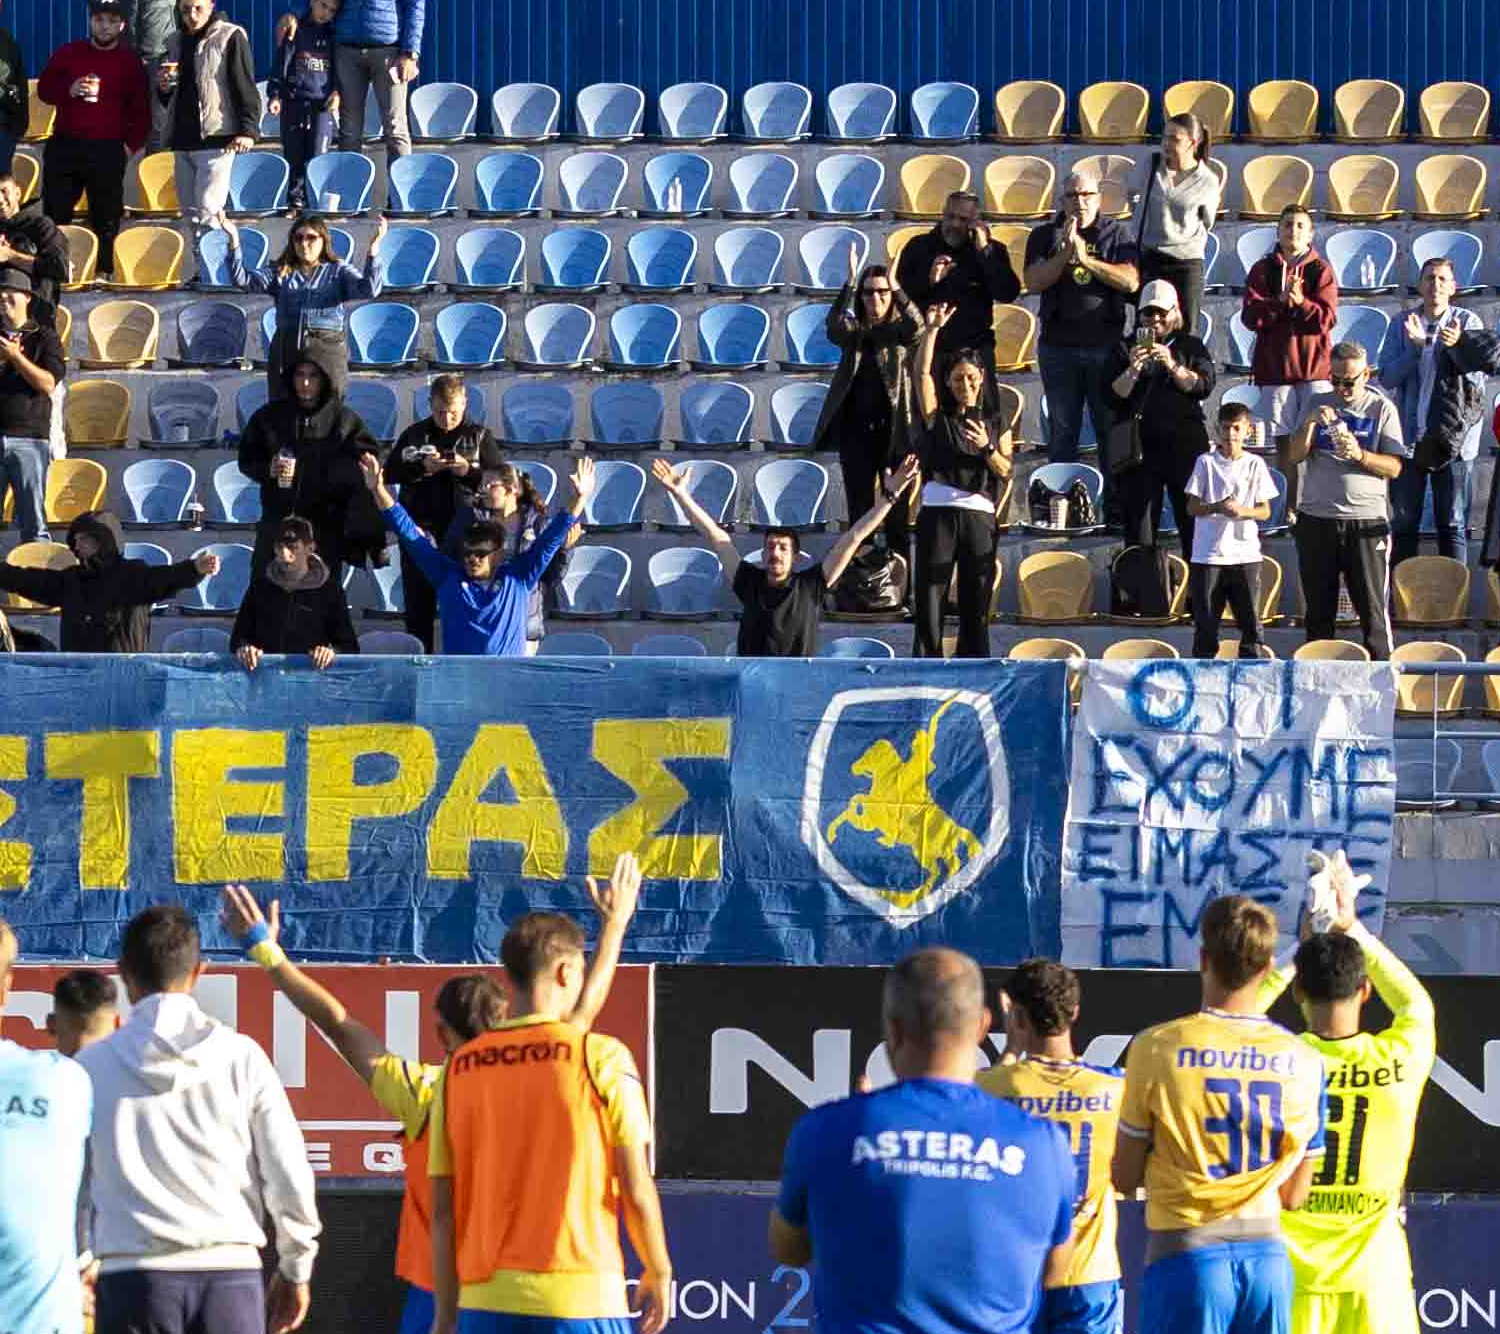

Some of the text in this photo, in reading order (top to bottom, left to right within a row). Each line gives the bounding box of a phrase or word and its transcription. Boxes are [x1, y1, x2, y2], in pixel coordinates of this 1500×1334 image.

[453, 1040, 573, 1075] macron
[1177, 1046, 1295, 1075] novibet
[1203, 1077, 1284, 1180] 30
[852, 1130, 1026, 1177] ASTERAS
